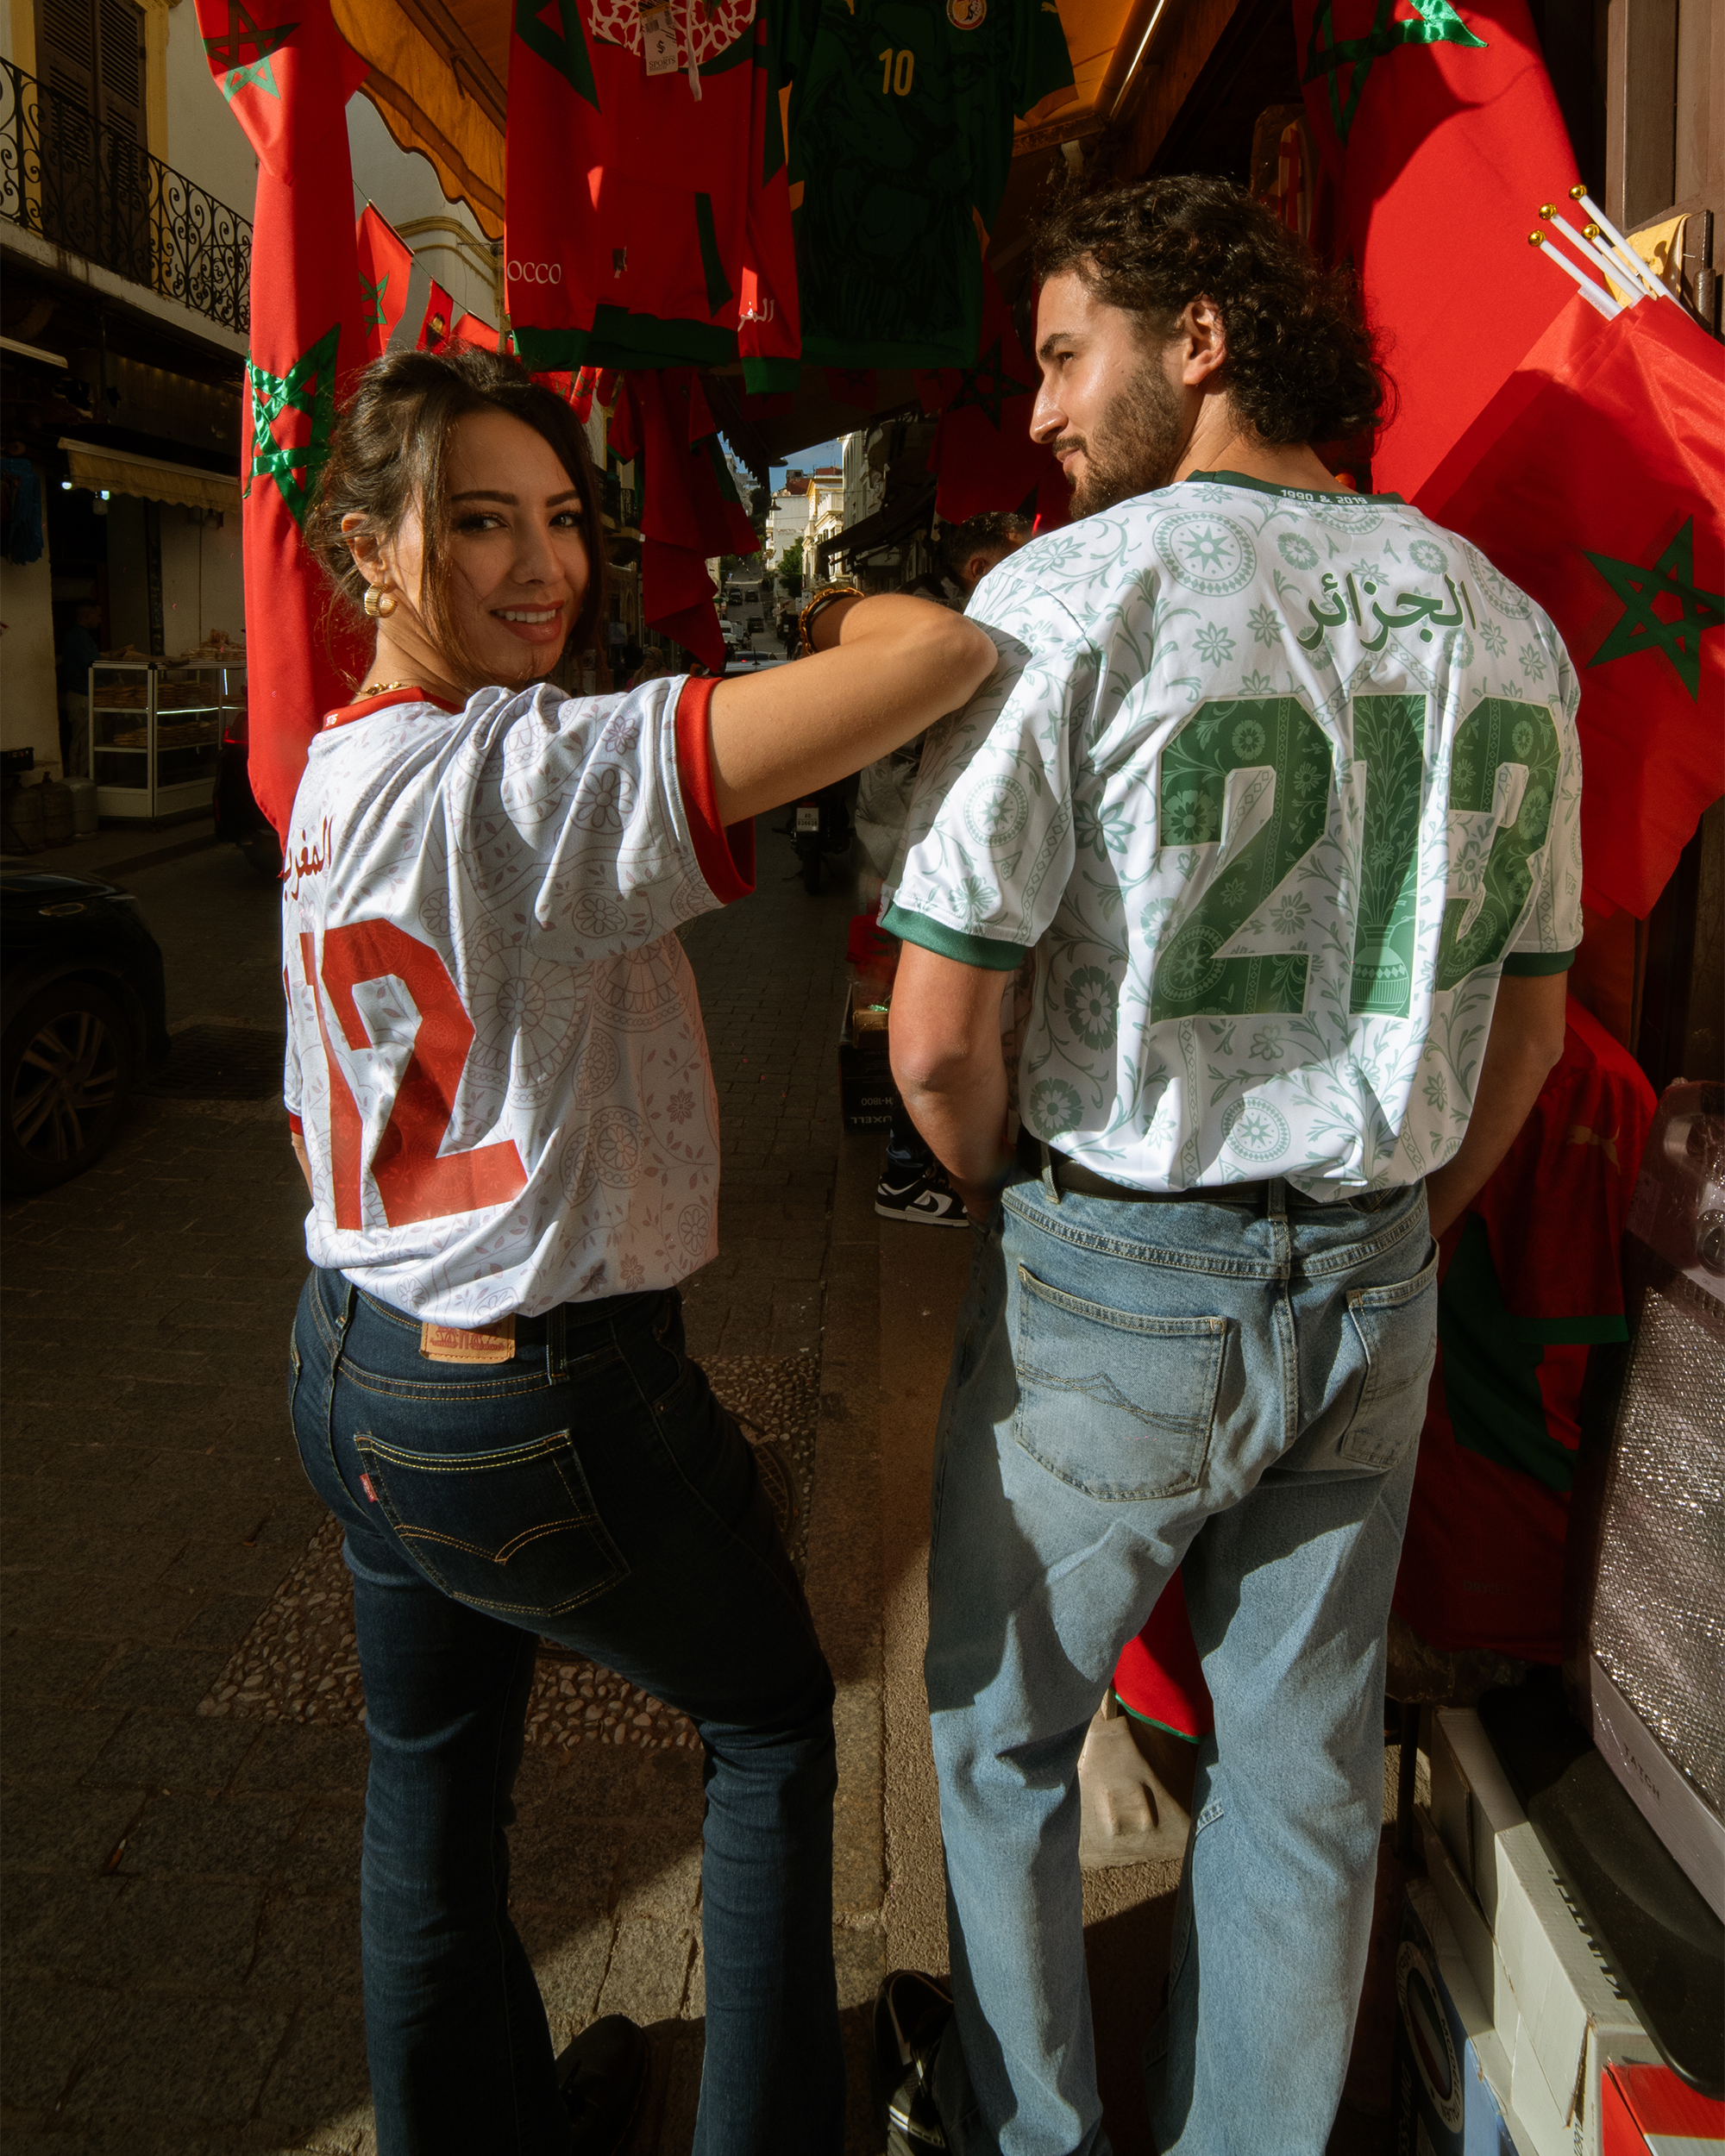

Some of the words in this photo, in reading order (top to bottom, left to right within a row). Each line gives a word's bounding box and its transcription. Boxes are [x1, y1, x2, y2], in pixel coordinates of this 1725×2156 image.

[649, 58, 675, 68] SPORTS
[879, 47, 914, 97] 10
[507, 260, 561, 285] OCCO
[1281, 489, 1314, 502] 1990
[1320, 494, 1333, 504] &
[1336, 496, 1368, 505] 2019
[1296, 573, 1477, 653] الجزائر
[1151, 691, 1562, 1025] 213
[283, 918, 529, 1231] 12
